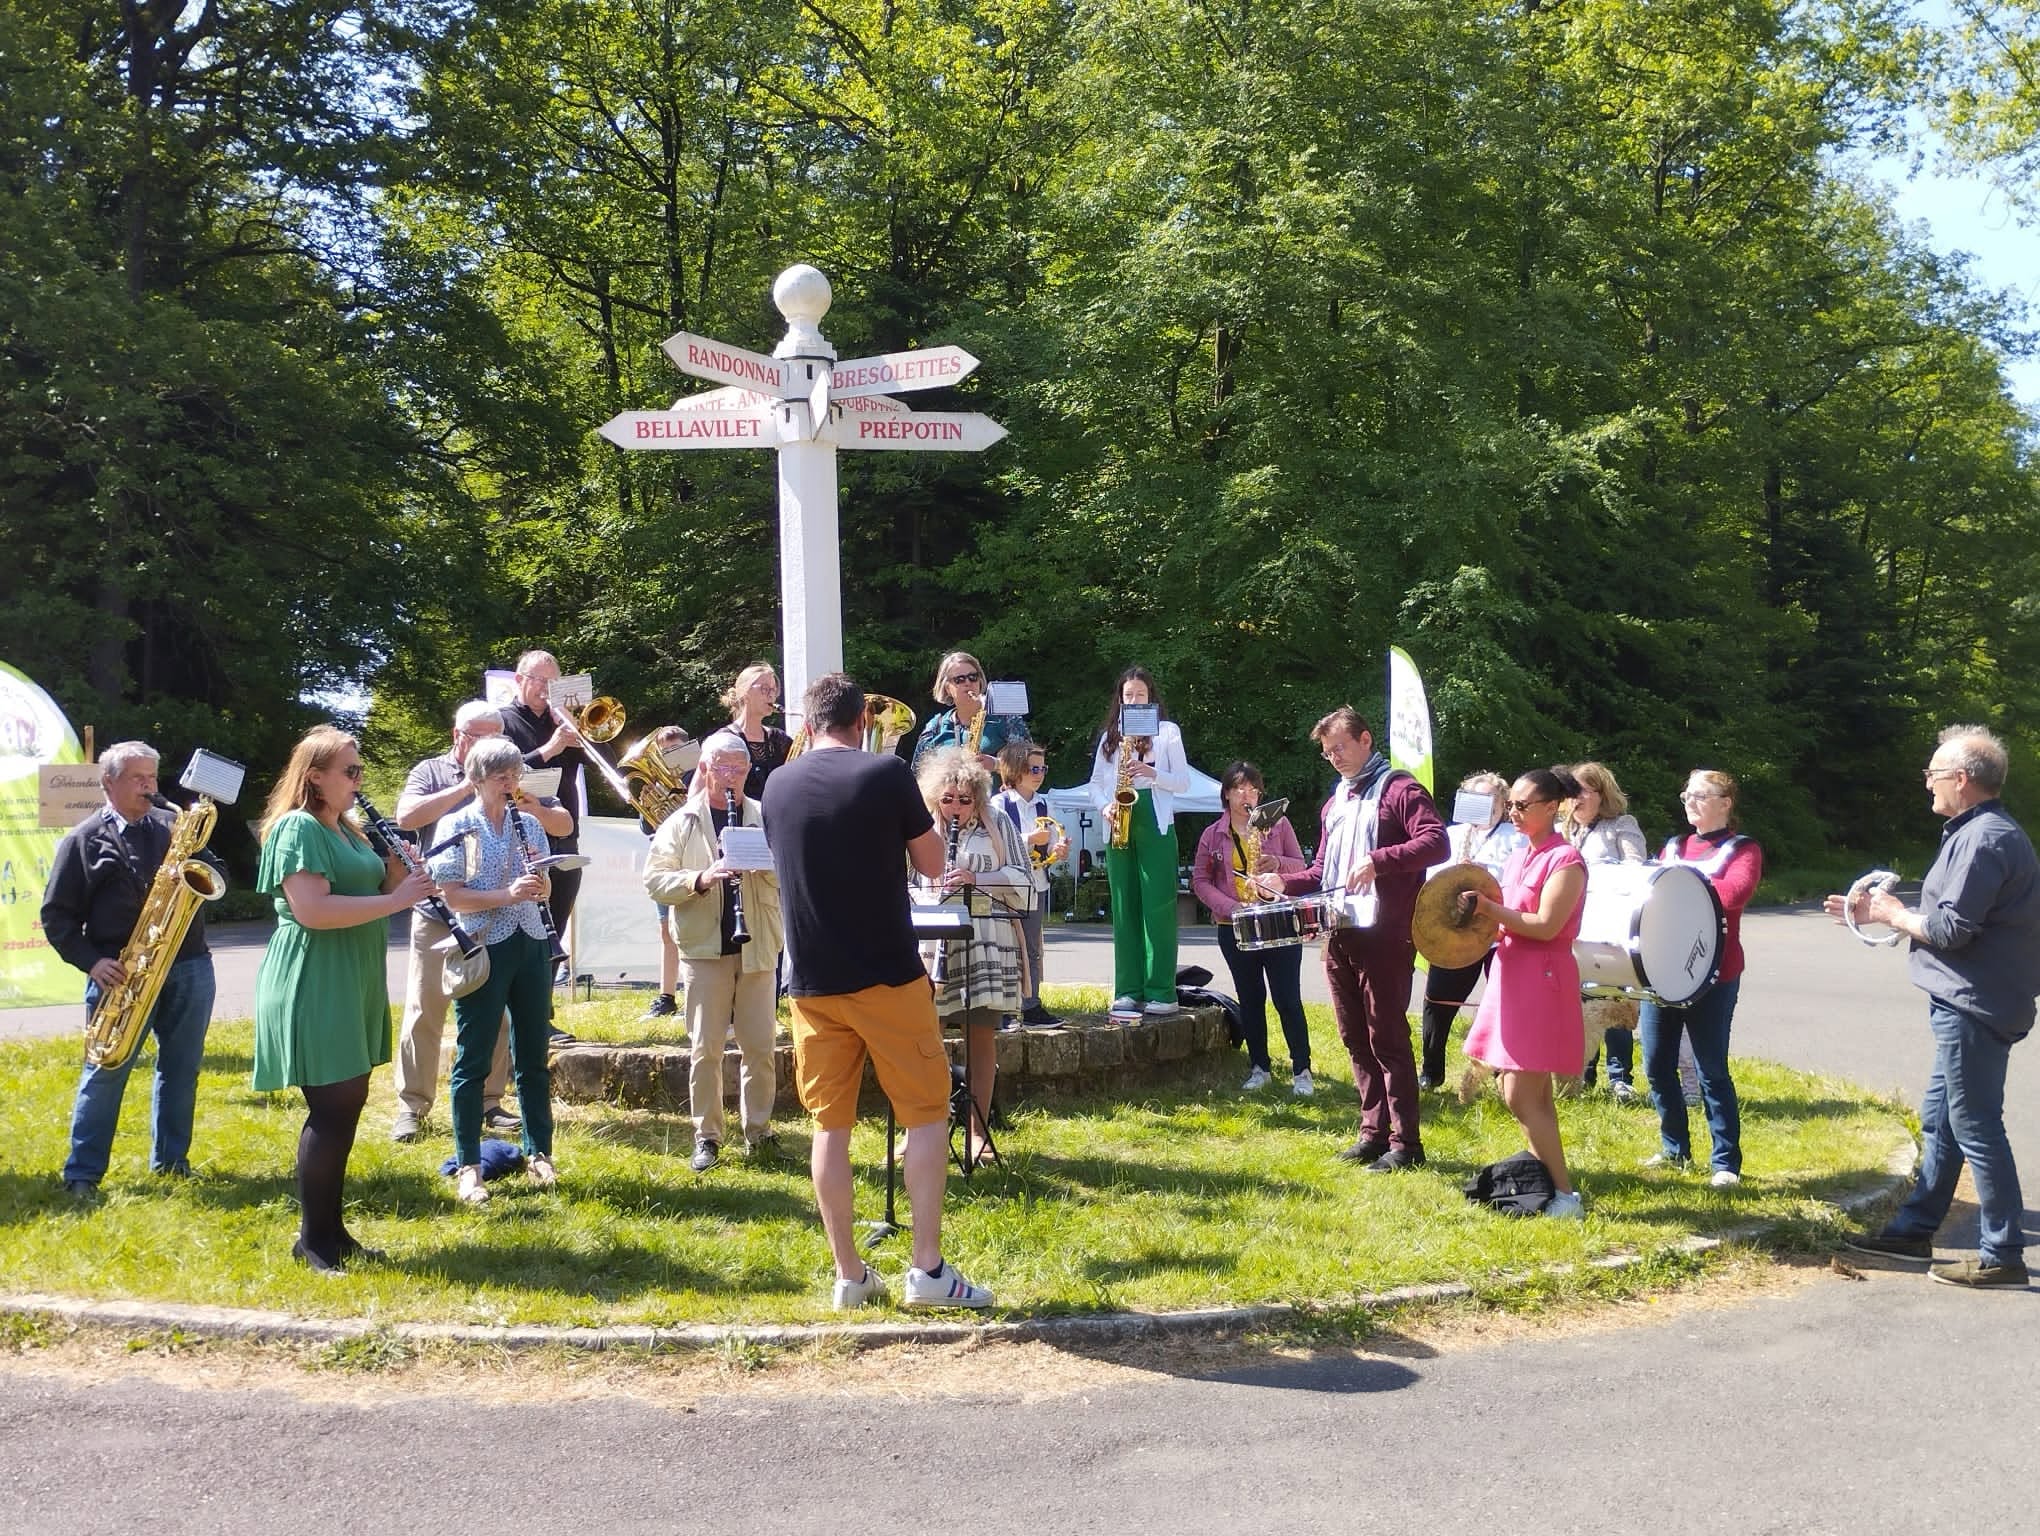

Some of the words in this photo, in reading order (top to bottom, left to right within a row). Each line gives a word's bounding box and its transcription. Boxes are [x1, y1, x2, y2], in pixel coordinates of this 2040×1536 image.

[688, 344, 781, 387] RANDONNAI
[832, 355, 961, 389] BRESOLETTES
[635, 420, 761, 438] BELLAVILET
[859, 416, 962, 440] PRÉPOTIN
